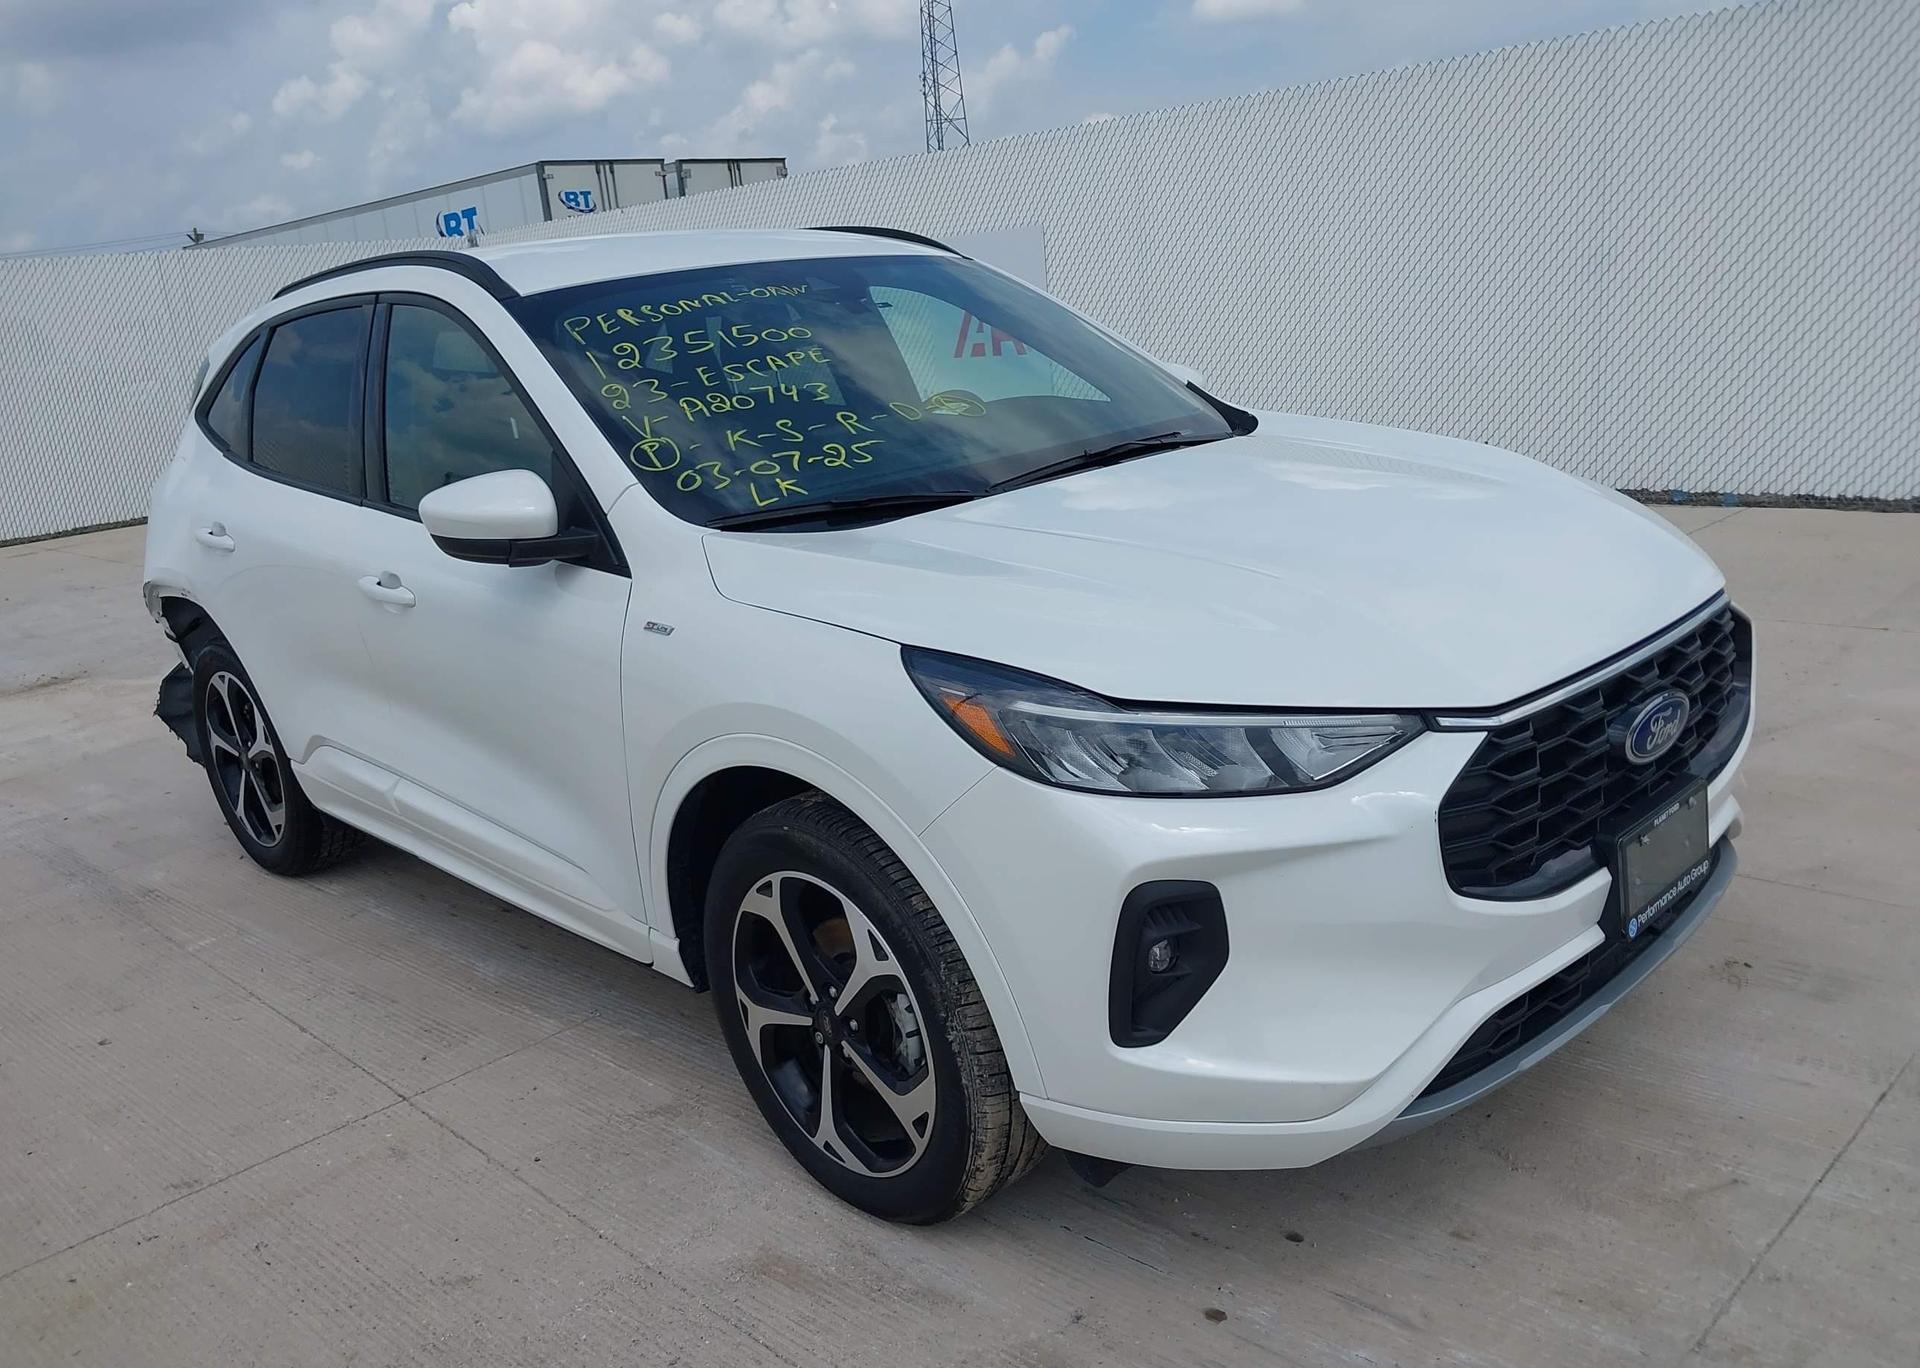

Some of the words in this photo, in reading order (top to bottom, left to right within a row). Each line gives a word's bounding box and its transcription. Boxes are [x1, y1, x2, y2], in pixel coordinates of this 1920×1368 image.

[586, 324, 813, 380] 12351500
[679, 382, 831, 424] A20743
[676, 439, 887, 492] 03-07-25
[749, 477, 810, 508] LK
[1646, 706, 1681, 751] Ford
[1637, 885, 1678, 928] Performance
[1676, 873, 1691, 893] Auto
[1690, 859, 1710, 881] Group
